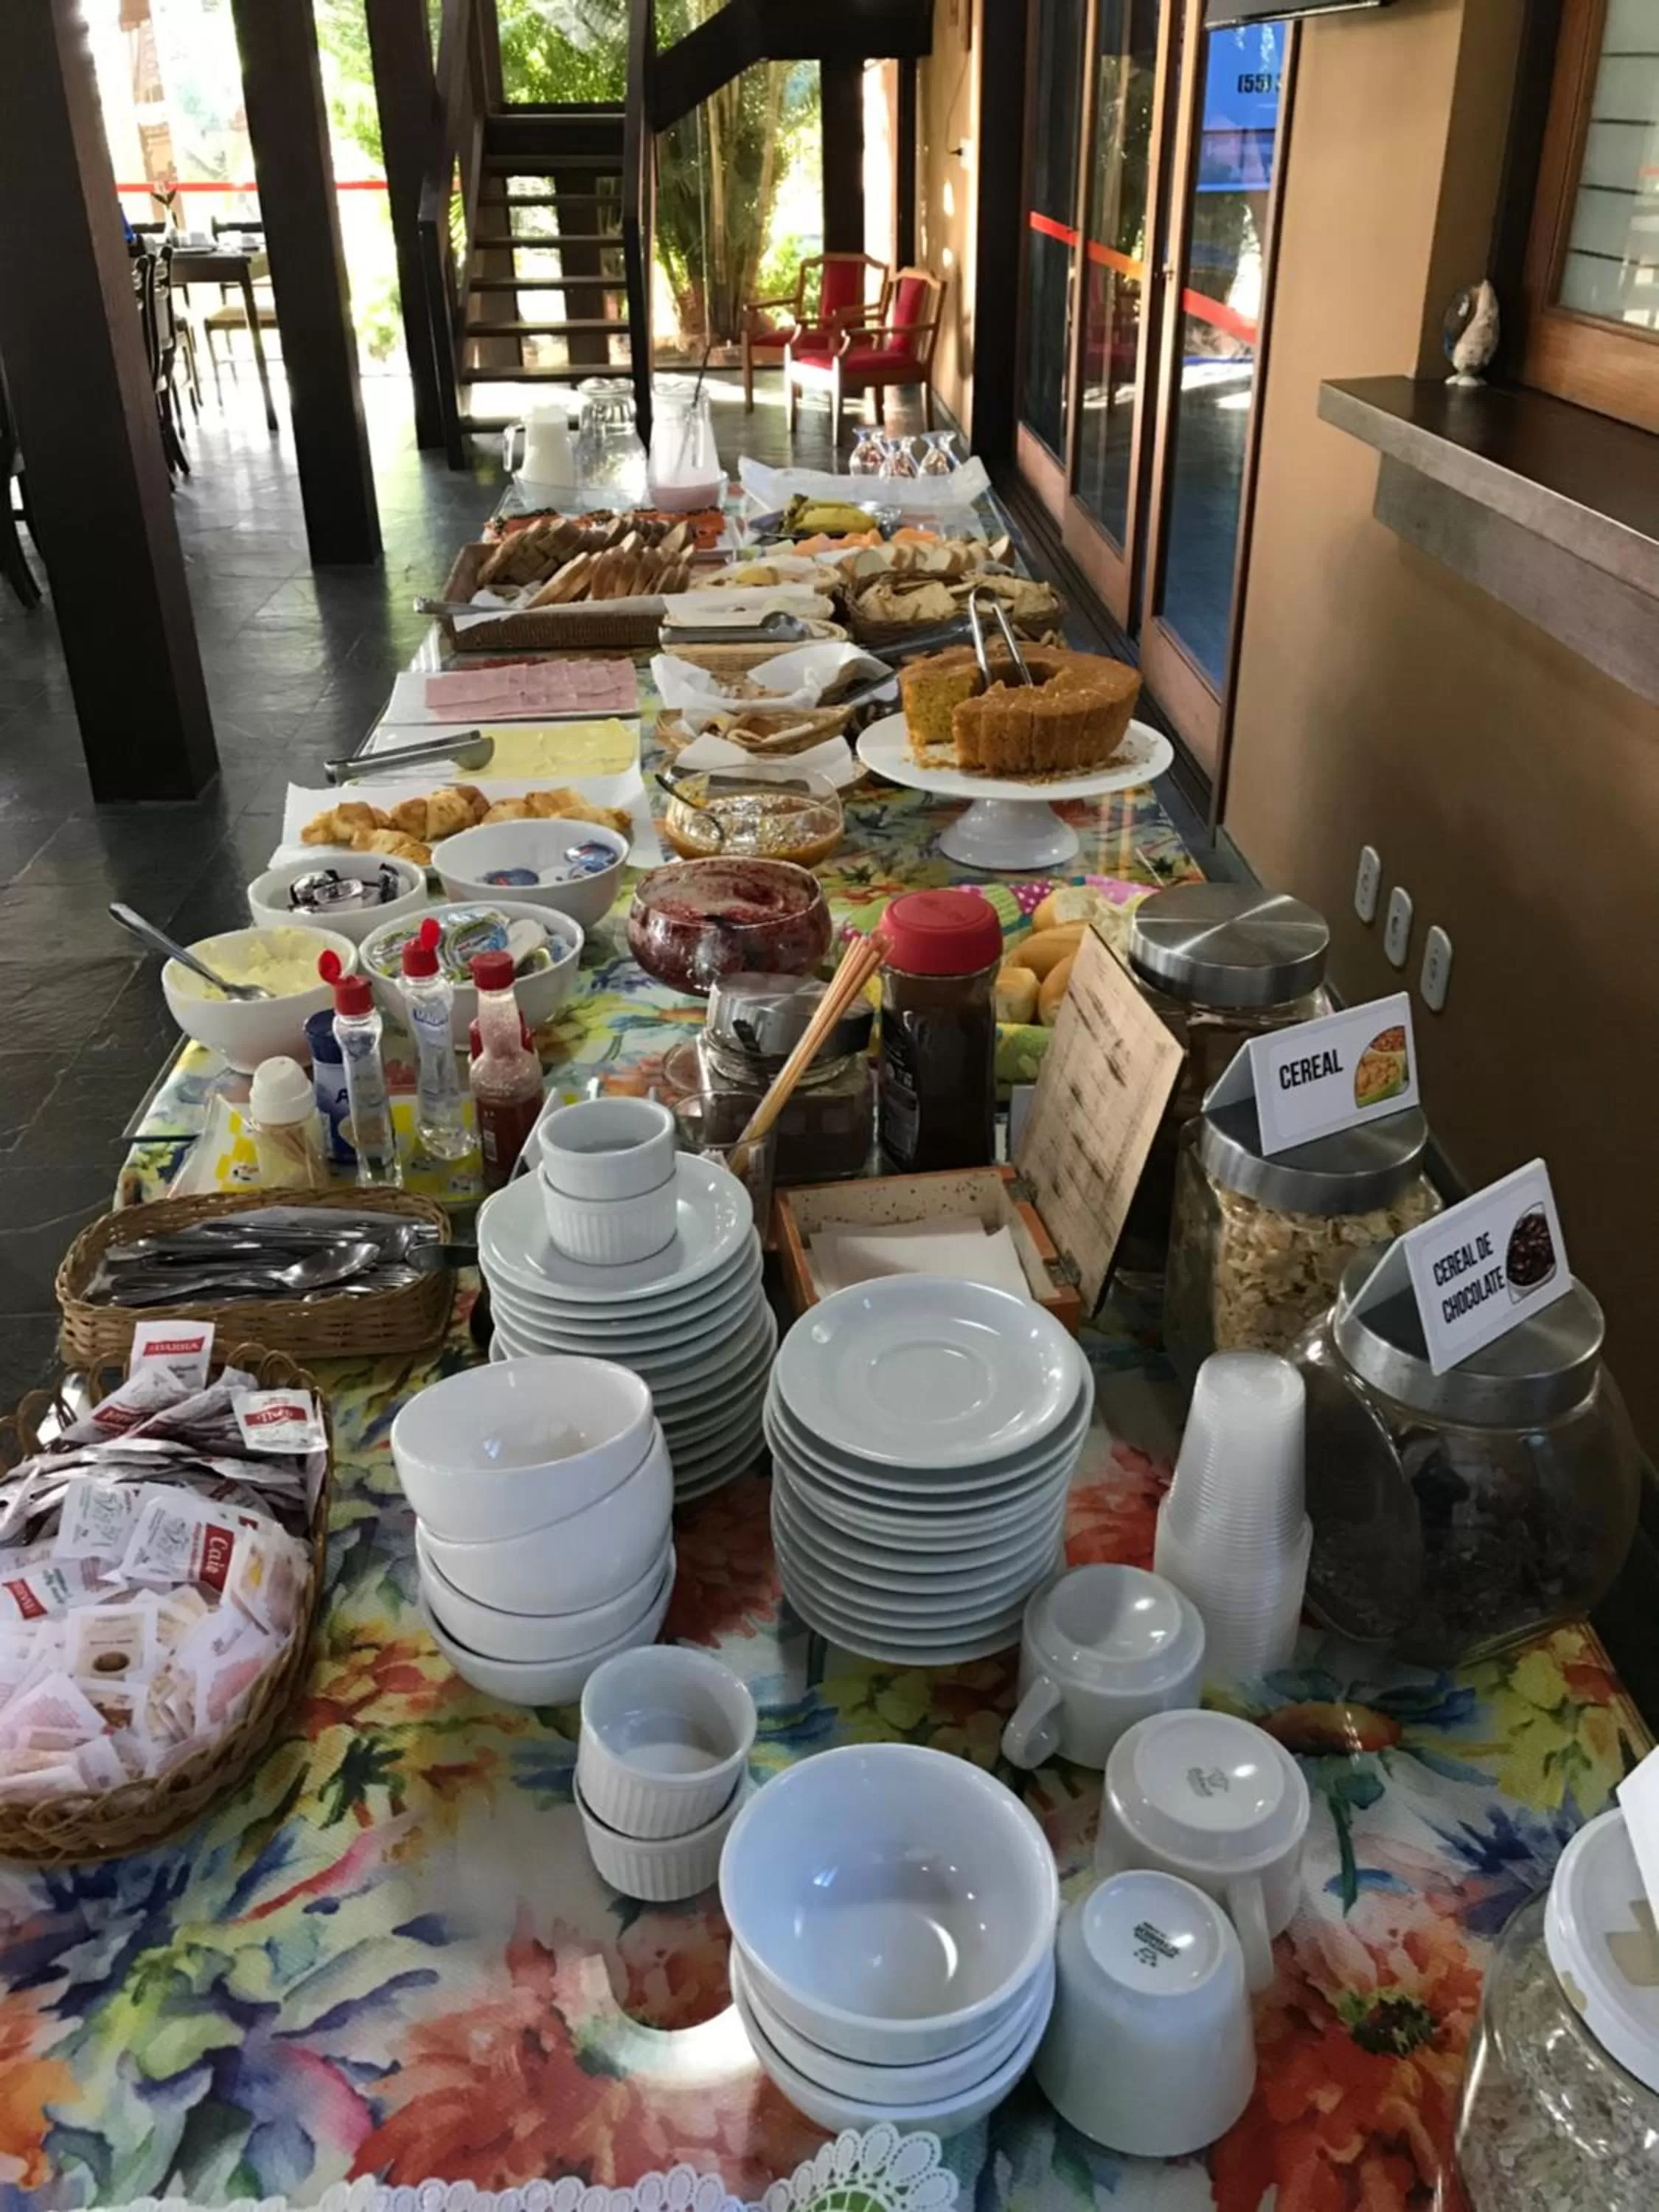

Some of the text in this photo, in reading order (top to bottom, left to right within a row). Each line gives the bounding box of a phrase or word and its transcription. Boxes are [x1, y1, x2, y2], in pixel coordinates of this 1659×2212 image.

[1278, 1048, 1344, 1091] CEREAL
[1432, 1231, 1494, 1287] CEREAL DE
[1441, 1265, 1505, 1325] CHOCOLATE
